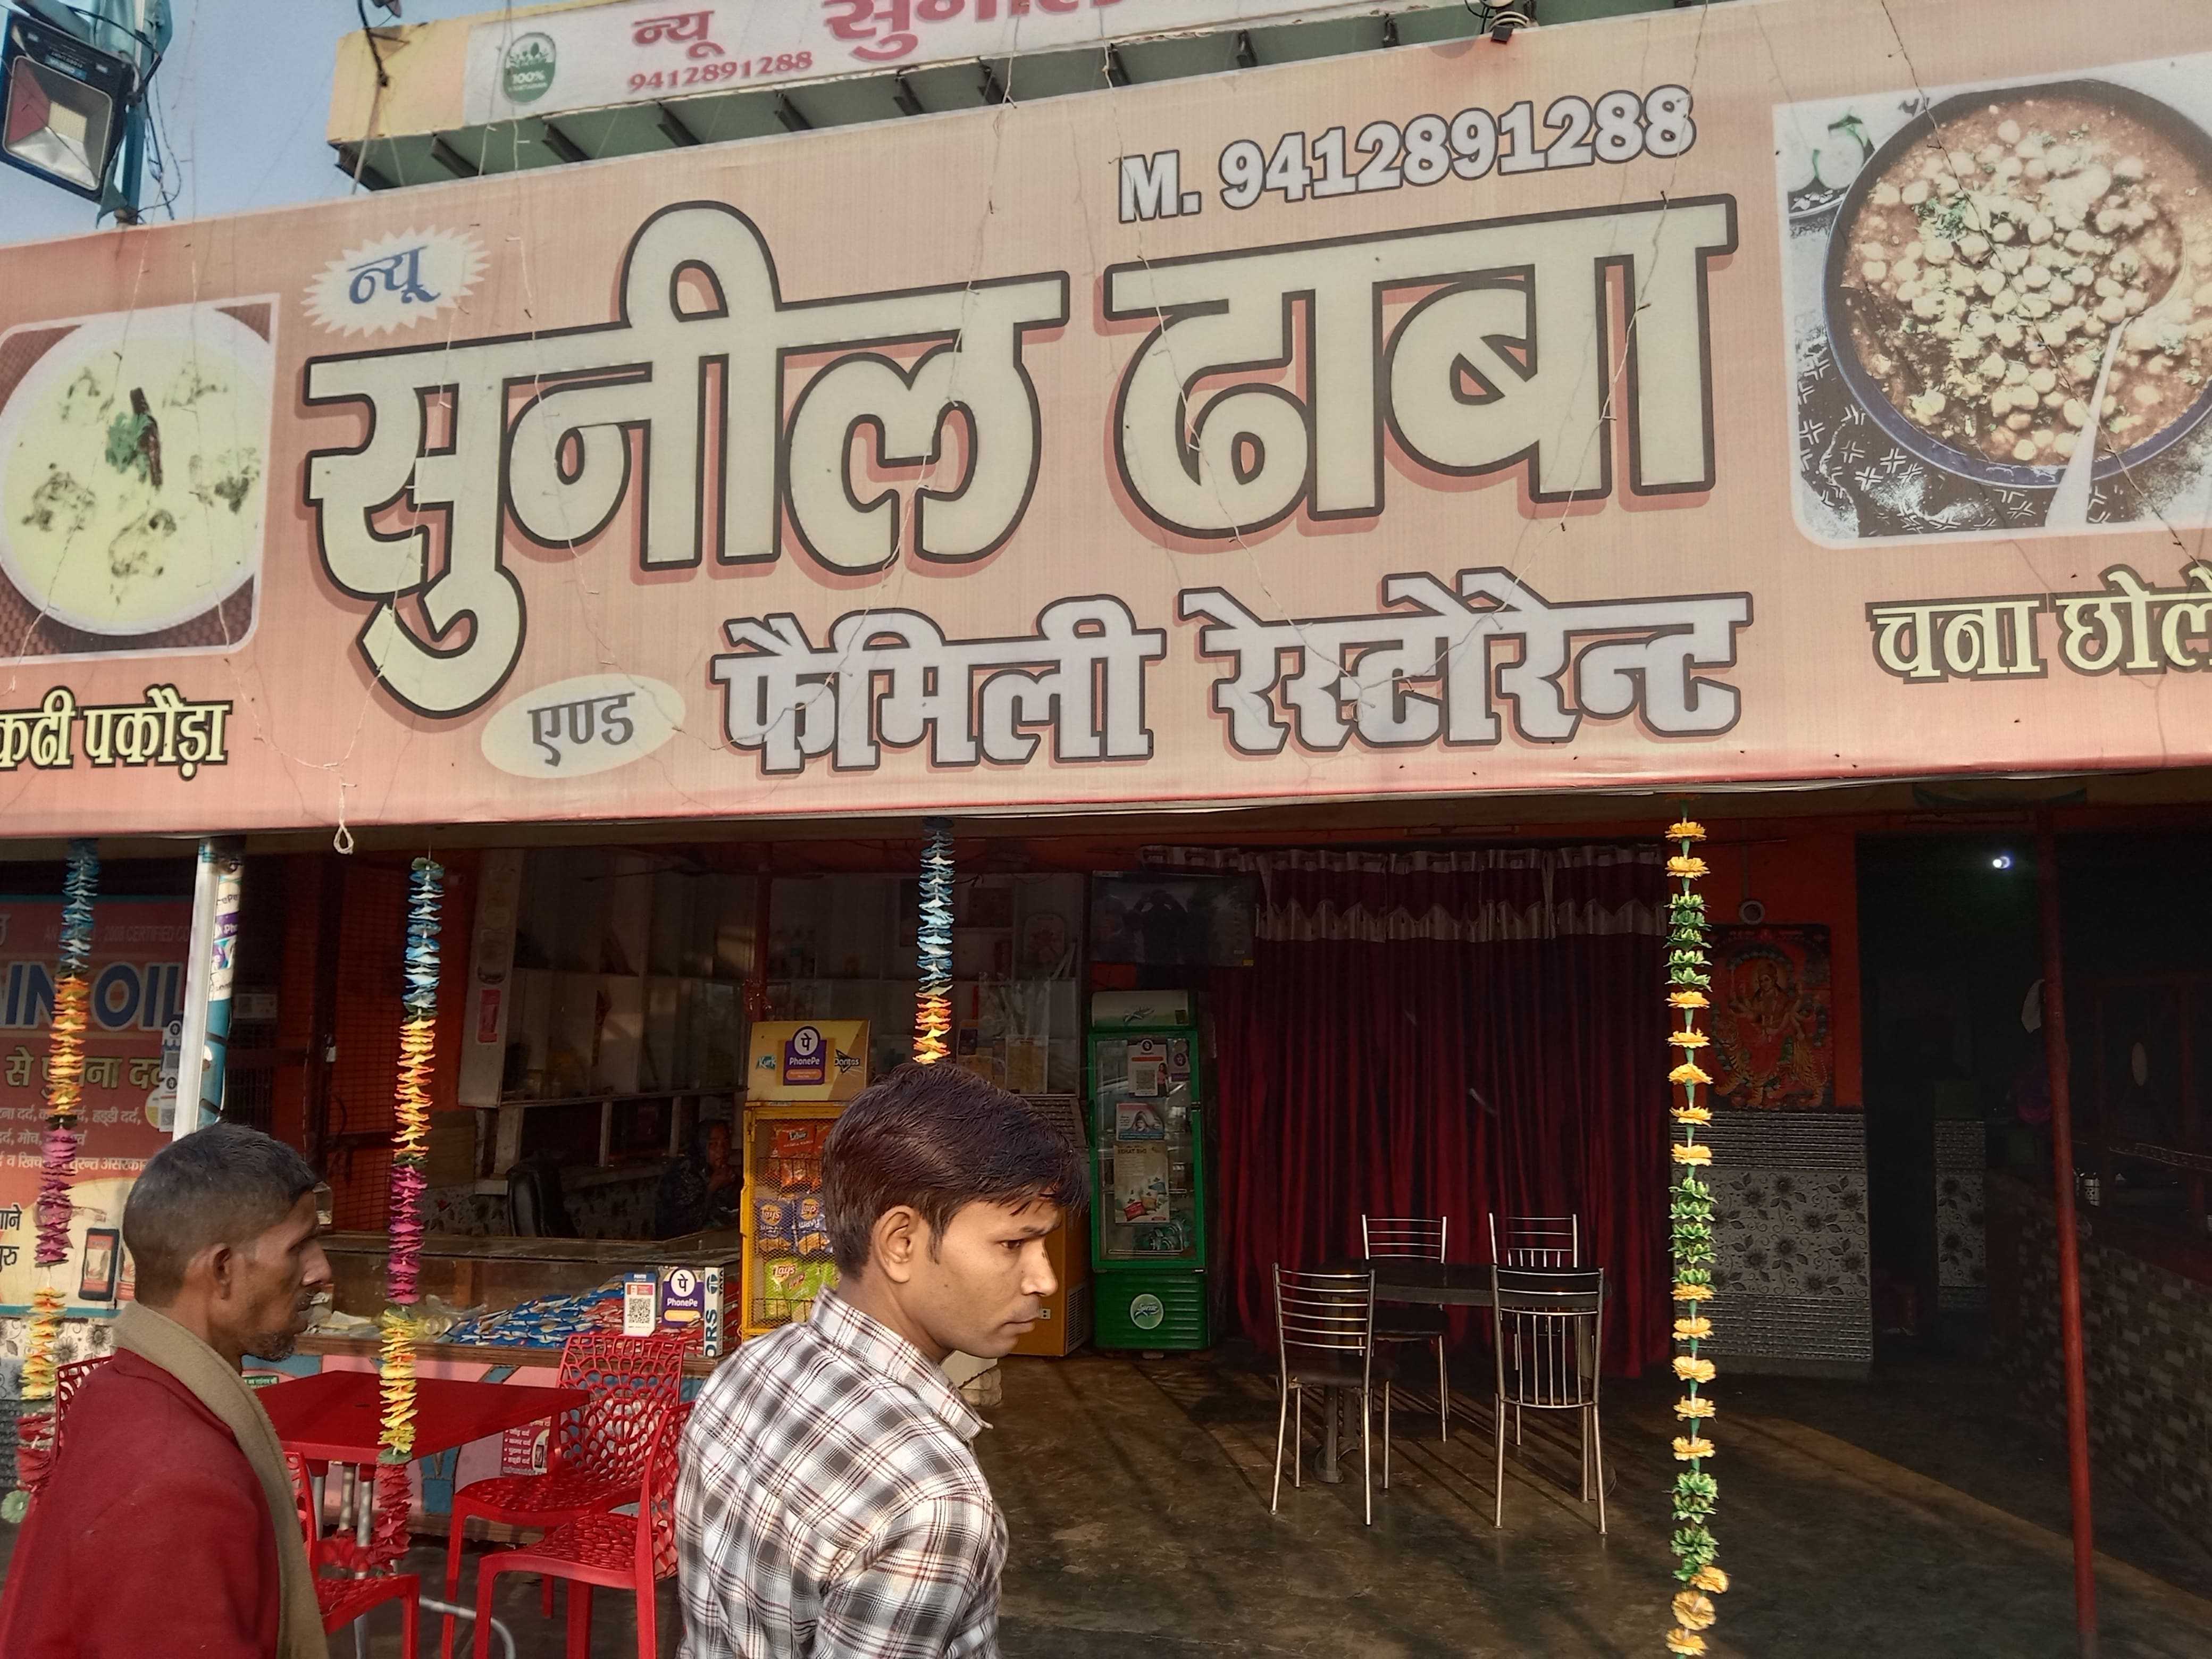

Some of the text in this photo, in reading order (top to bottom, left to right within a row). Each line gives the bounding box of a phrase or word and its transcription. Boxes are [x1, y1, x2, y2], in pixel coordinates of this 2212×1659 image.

[632, 11, 724, 57] न्यू
[512, 70, 546, 85] 100%
[628, 52, 813, 92] 9412891288
[1118, 83, 1696, 223] M. 9412891288
[347, 245, 441, 304] न्यू
[304, 192, 1738, 719] सुनील ढाबा
[1866, 594, 2046, 682] चना
[527, 692, 636, 767] एण्ड
[709, 594, 1167, 775] फैमिली
[80, 683, 233, 781] पकौड़ा
[789, 1057, 820, 1066] PhonePe
[801, 1033, 812, 1051] पे
[667, 1297, 698, 1307] PhonePe
[677, 1273, 688, 1292] पे
